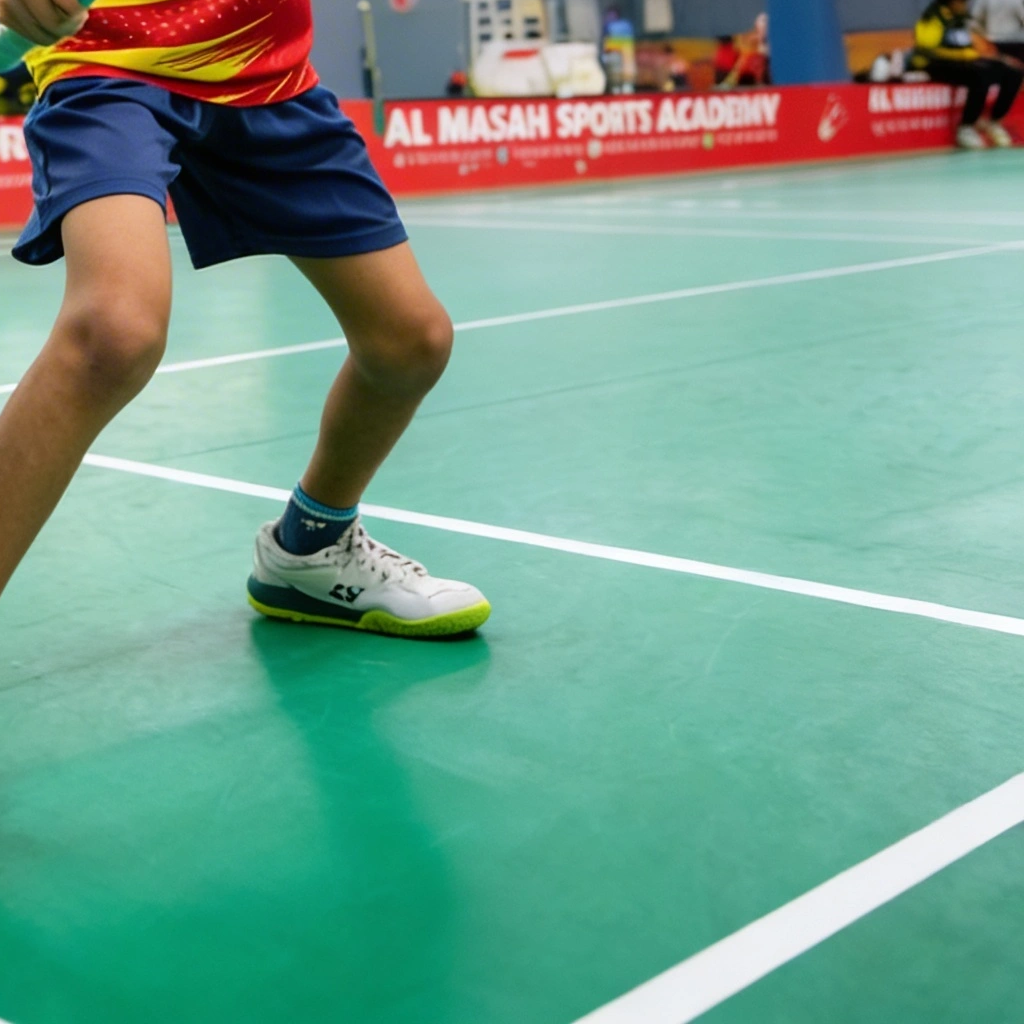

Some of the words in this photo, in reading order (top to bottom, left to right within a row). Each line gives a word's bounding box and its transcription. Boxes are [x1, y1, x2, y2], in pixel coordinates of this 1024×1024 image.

[383, 108, 433, 148] AL
[437, 103, 551, 145] MASAH
[555, 99, 653, 139] SPORTS
